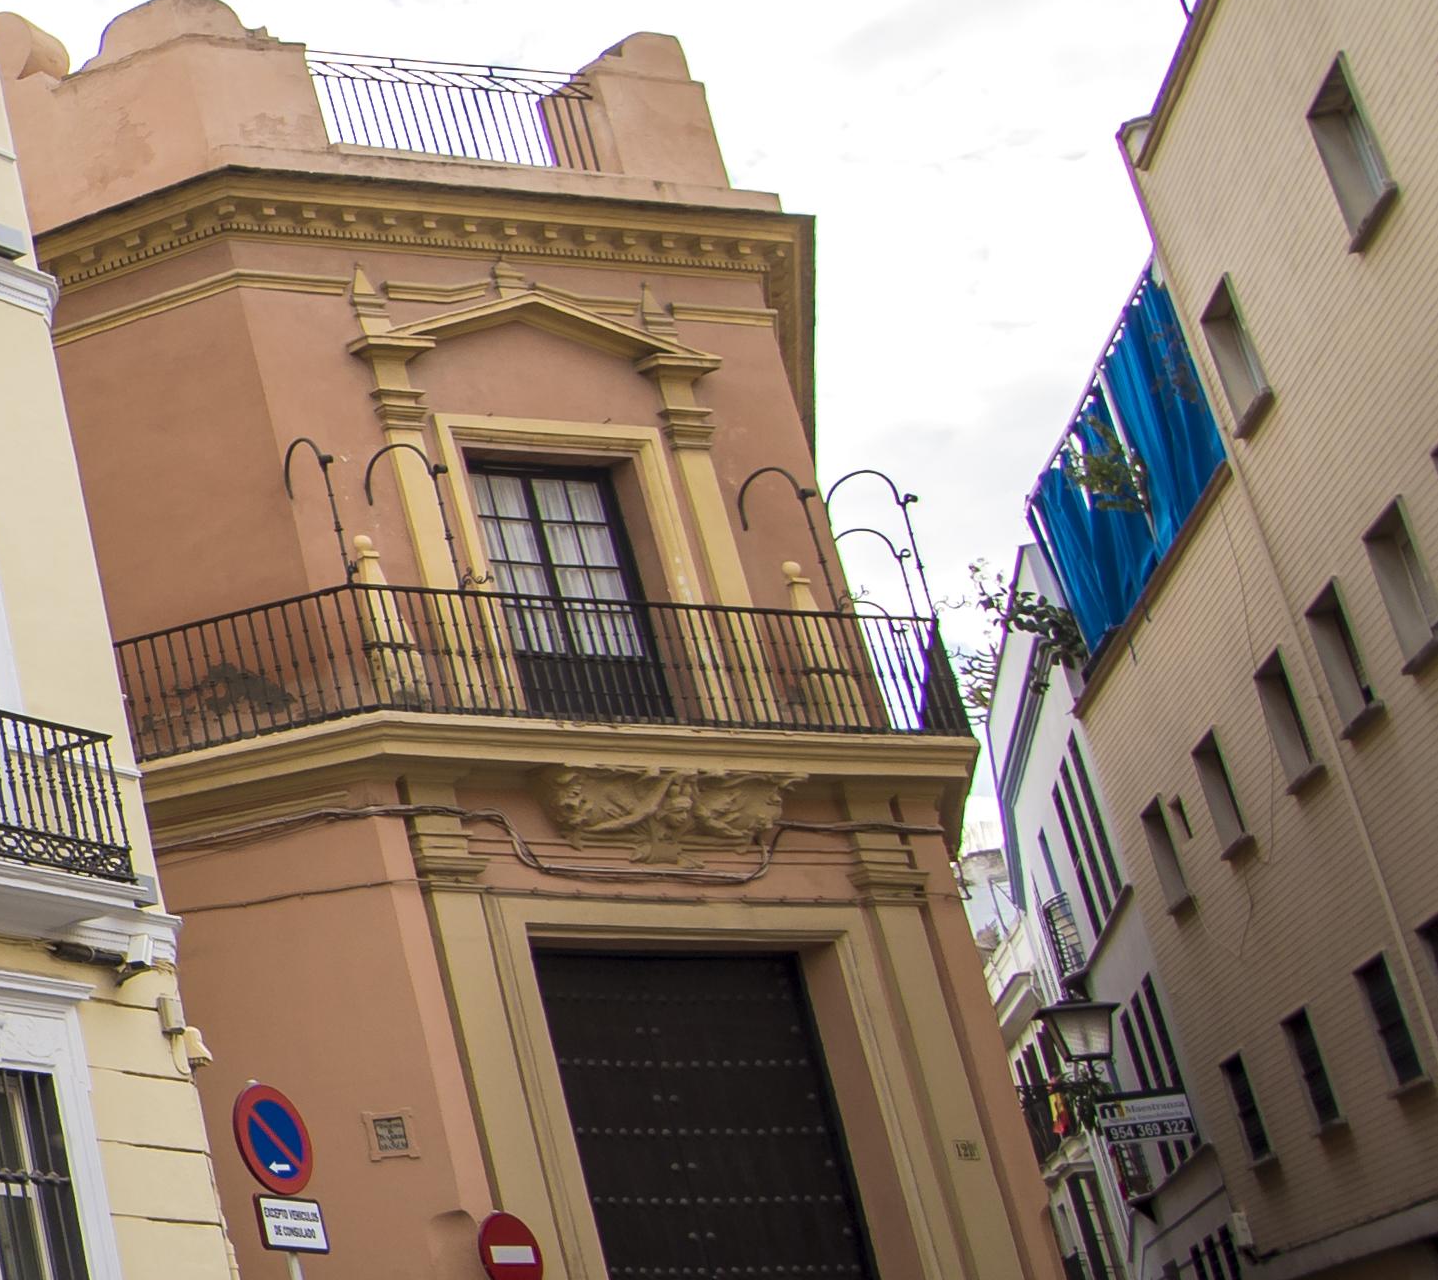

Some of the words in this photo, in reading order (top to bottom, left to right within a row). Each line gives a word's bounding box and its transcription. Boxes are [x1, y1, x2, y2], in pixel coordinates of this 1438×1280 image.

[1110, 1126, 1135, 1140] 954
[1137, 1122, 1161, 1137] 369
[1163, 1120, 1189, 1134] 322
[274, 1224, 283, 1236] DE
